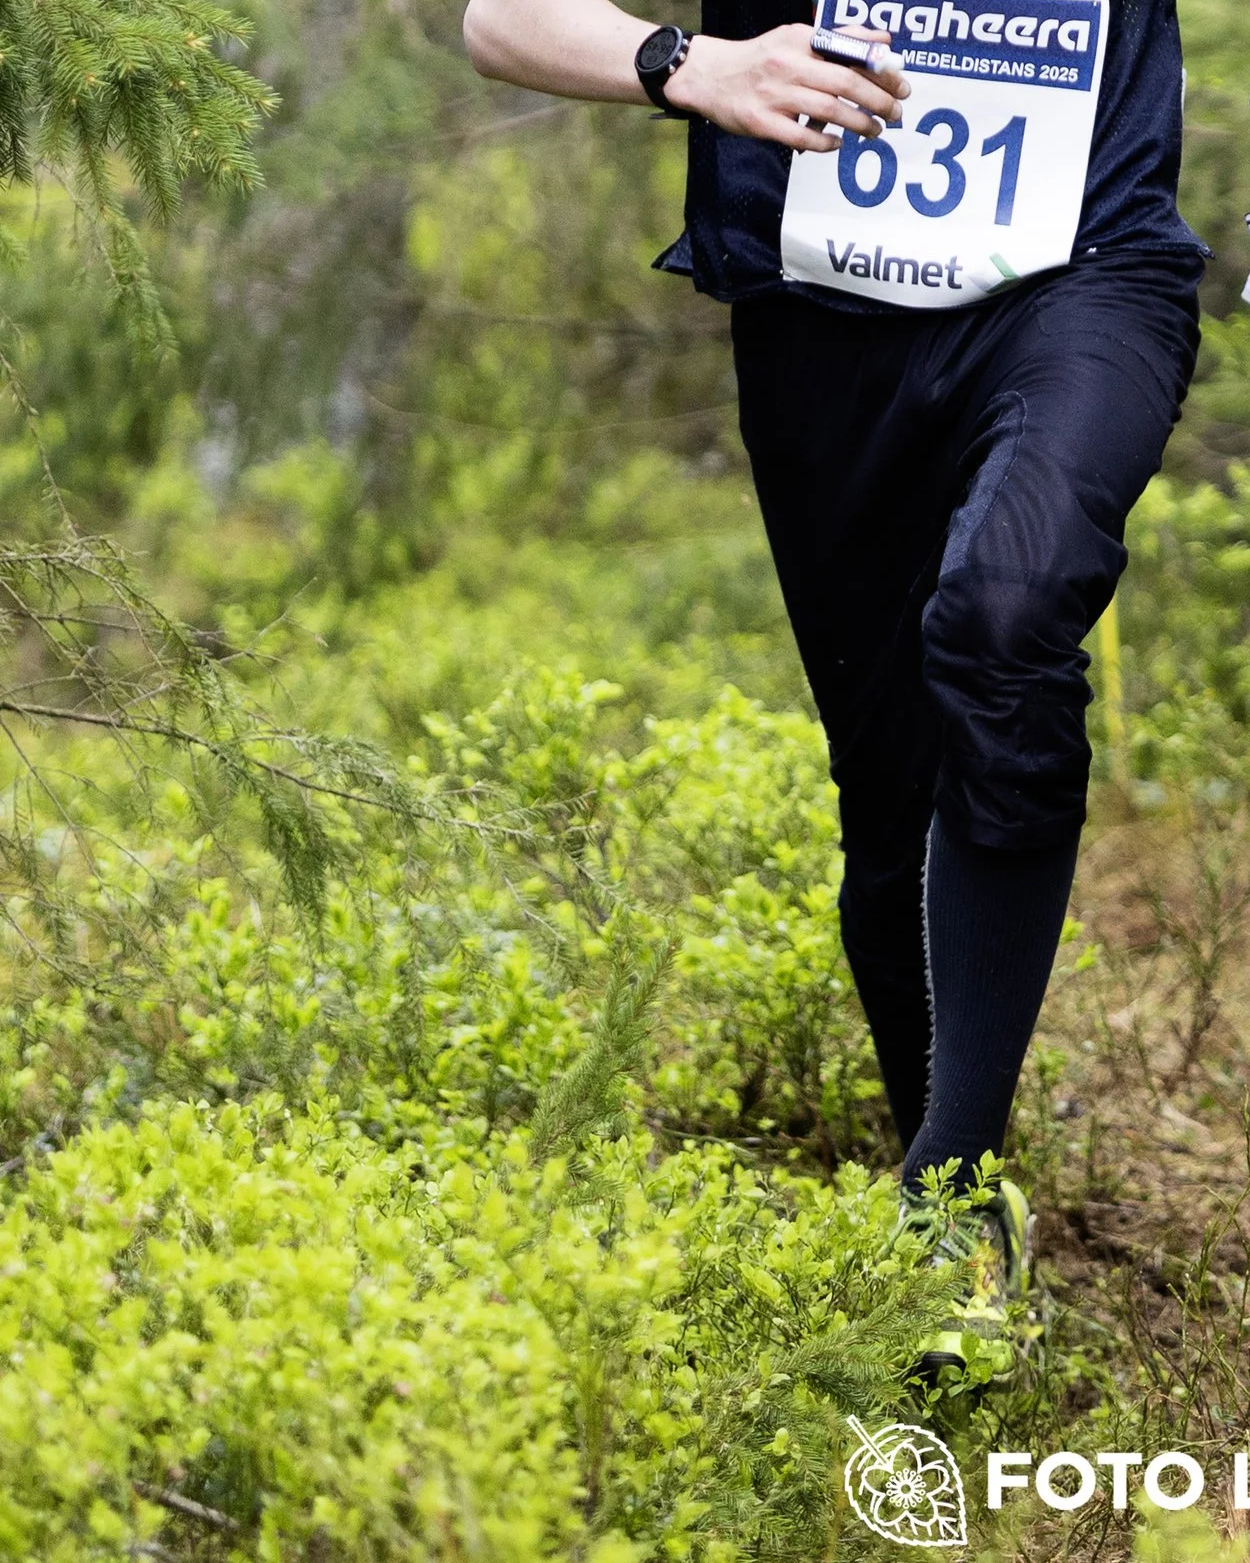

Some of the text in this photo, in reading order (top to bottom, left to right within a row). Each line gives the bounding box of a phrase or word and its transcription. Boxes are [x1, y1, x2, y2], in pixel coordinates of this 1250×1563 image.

[901, 48, 1079, 83] MEDELDISTANS 2025
[837, 105, 1027, 226] 631
[826, 238, 963, 290] Valmet
